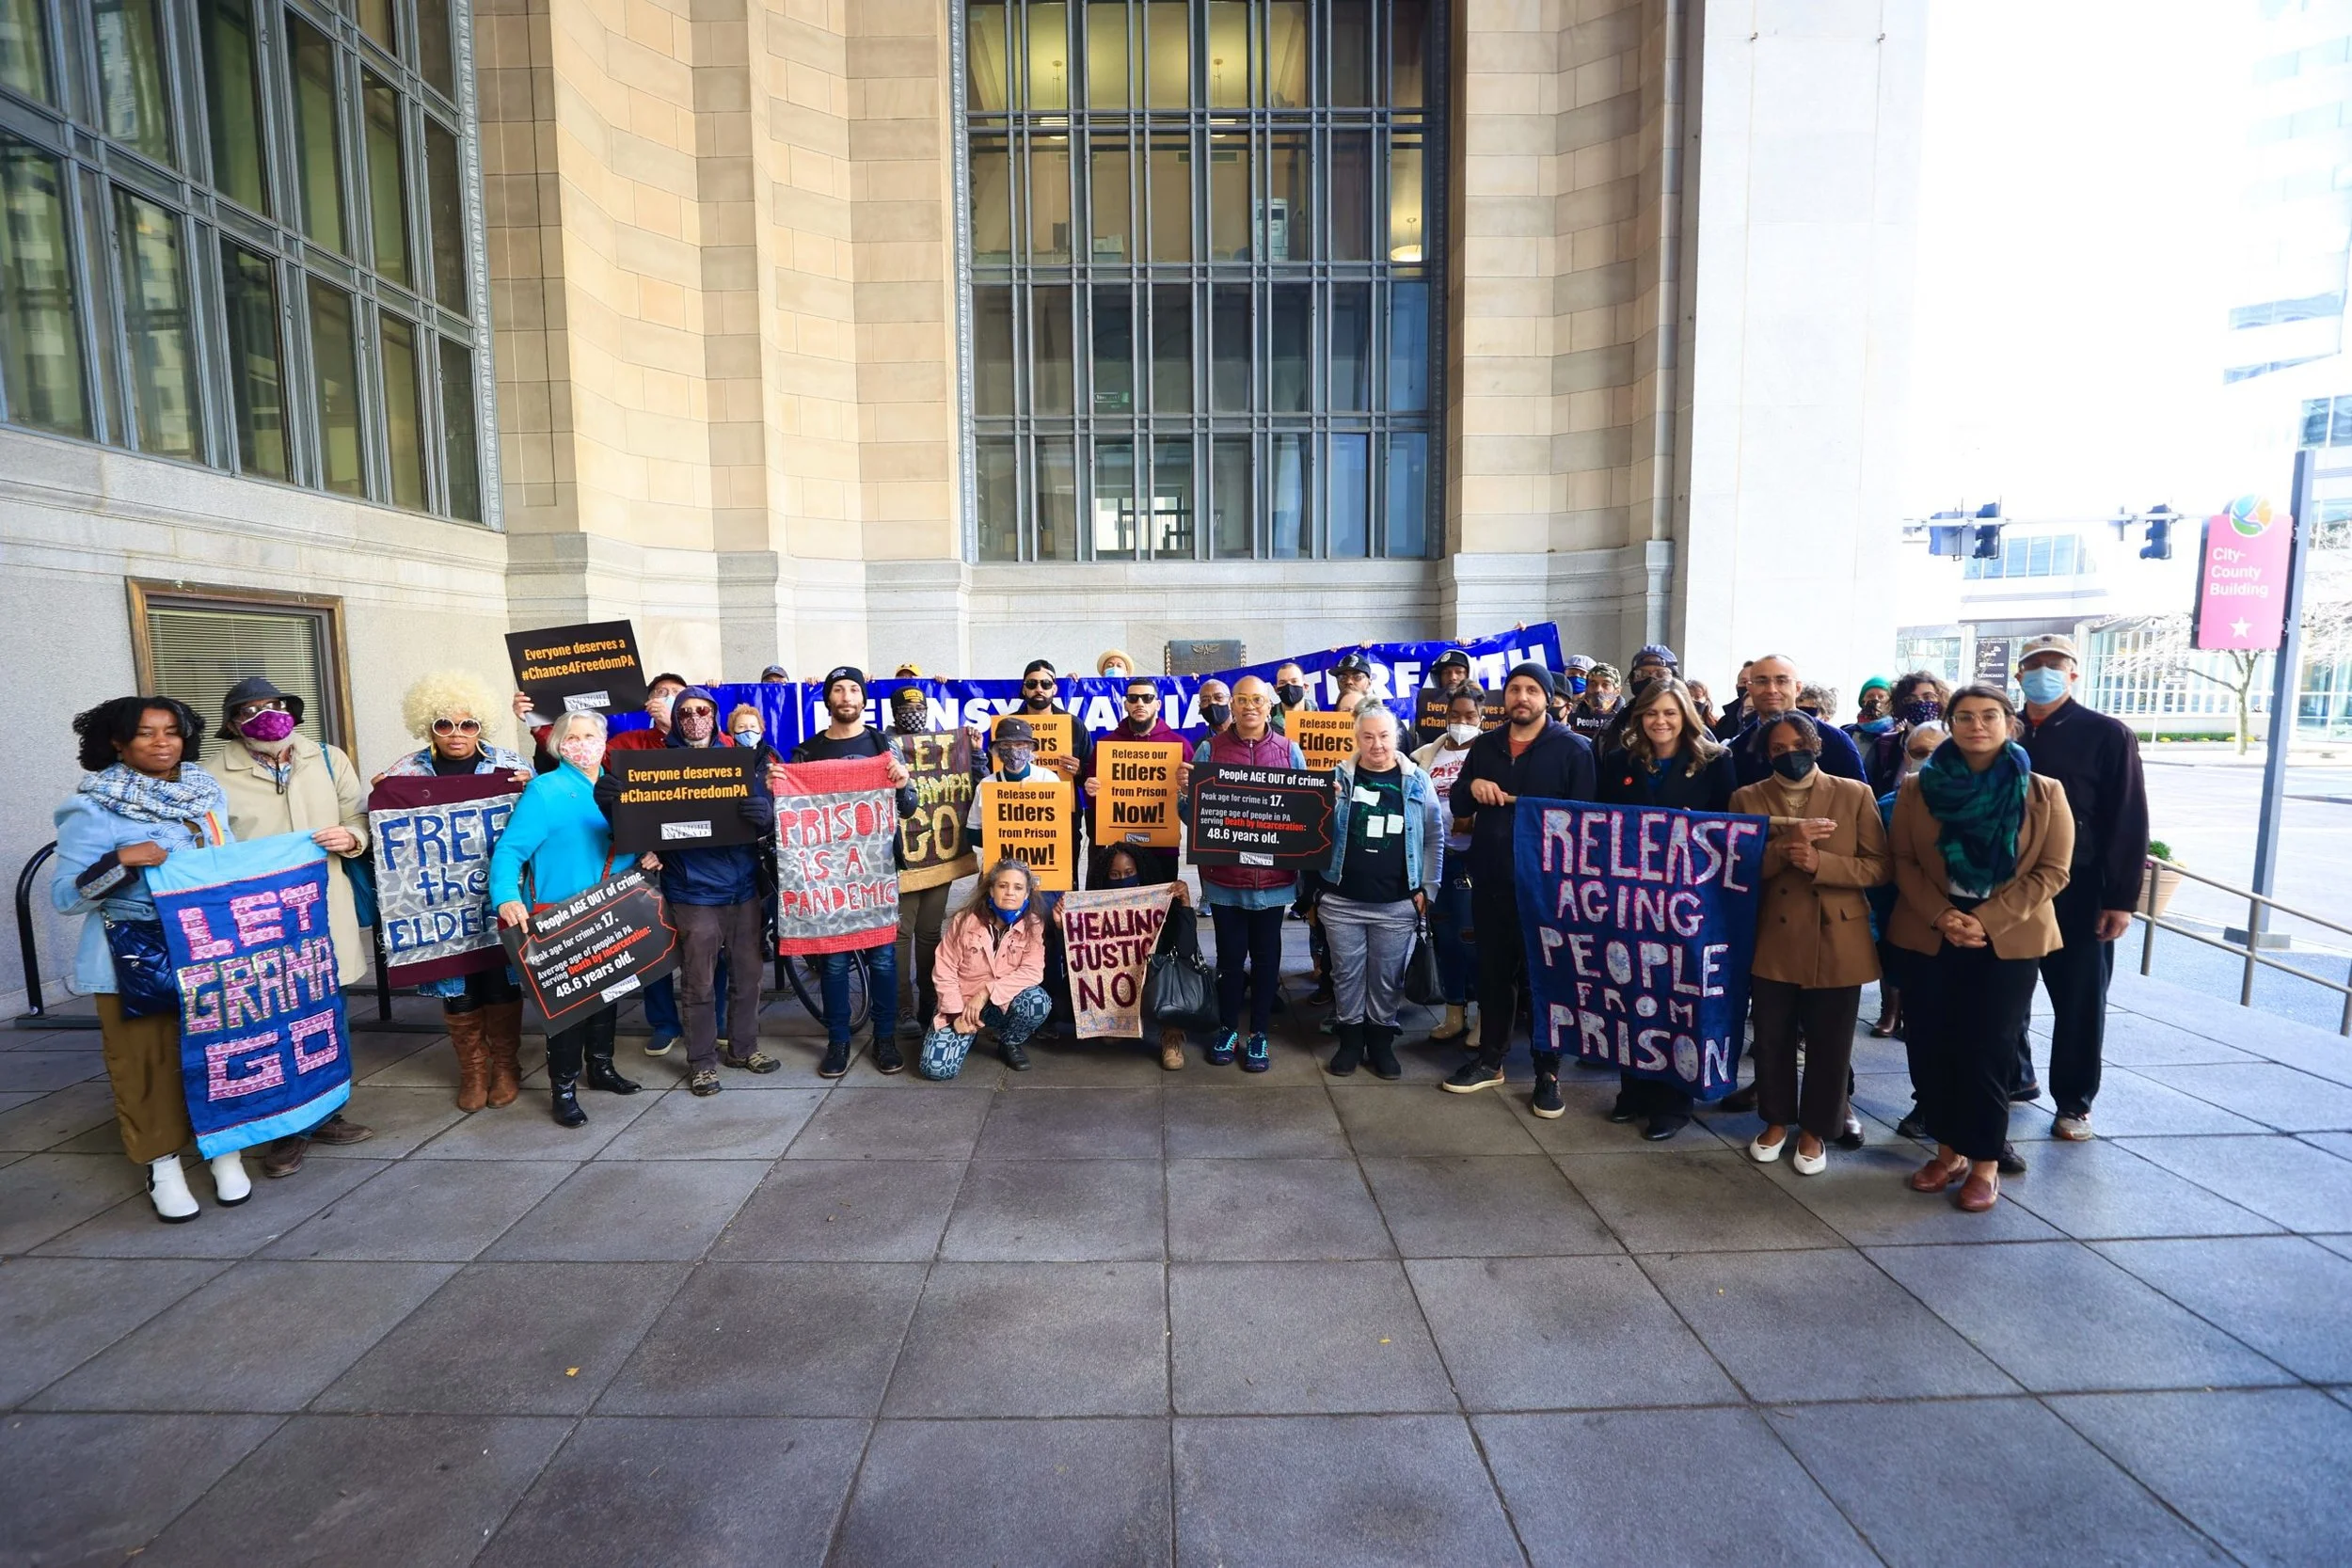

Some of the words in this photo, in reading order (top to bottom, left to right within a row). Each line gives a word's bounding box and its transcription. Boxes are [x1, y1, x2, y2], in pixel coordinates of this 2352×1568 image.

[2212, 546, 2246, 563] City-
[2211, 564, 2262, 581] County
[2210, 582, 2268, 598] Building
[524, 644, 571, 661] Everyone
[573, 640, 617, 654] deserves
[618, 639, 626, 649] a
[521, 654, 635, 681] #Chance4FreedomPA
[1426, 702, 1449, 714] Every
[1042, 722, 1057, 732] our
[1299, 719, 1337, 729] Release
[1339, 721, 1355, 730] our
[1577, 717, 1599, 728] People
[1299, 732, 1354, 752] Elders
[1036, 756, 1059, 767] rison
[1112, 749, 1150, 759] Release
[1152, 751, 1168, 760] our
[628, 768, 680, 784] Everyone
[683, 767, 732, 779] deserves
[734, 767, 742, 778] a
[1112, 763, 1167, 781] Elders
[1219, 768, 1248, 783] People
[1249, 771, 1266, 784] AGE
[1267, 773, 1286, 784] OUT
[1287, 774, 1297, 785] of
[1298, 775, 1327, 787] crime.
[619, 784, 749, 803] #Chance4FreedomPA
[997, 789, 1037, 800] Release
[1039, 791, 1055, 800] our
[1111, 786, 1135, 797] from
[1136, 786, 1168, 797] Prison
[1200, 792, 1216, 801] Peak
[1217, 794, 1230, 803] age
[1231, 793, 1241, 802] for
[1242, 795, 1261, 804] crime
[1262, 797, 1268, 805] is
[1269, 794, 1284, 807] 17.
[997, 803, 1056, 822] Elders
[1113, 801, 1165, 823] Now!
[1200, 808, 1228, 818] Average
[1229, 810, 1241, 818] age
[1242, 810, 1249, 818] of
[1249, 811, 1273, 822] people
[1274, 812, 1280, 821] in
[1281, 813, 1291, 822] PA
[778, 798, 895, 848] PRISON
[899, 804, 960, 863] GO
[998, 828, 1023, 838] from
[1025, 828, 1057, 838] Prison
[1200, 817, 1224, 827] serving
[1224, 817, 1246, 827] Death
[1246, 818, 1255, 830] by
[1207, 828, 1230, 840] 48.6
[1232, 831, 1260, 843] years
[1261, 832, 1280, 845] old.
[1000, 844, 1055, 865] Now!
[1542, 809, 1757, 893] RELEASE
[844, 847, 865, 877] A
[416, 866, 489, 906] the
[535, 909, 571, 933] People
[569, 898, 589, 917] AGE
[587, 889, 607, 907] OUT
[606, 882, 617, 897] of
[616, 872, 645, 892] crime.
[782, 882, 897, 917] PANDEMIC
[1557, 879, 1704, 938] AGING
[178, 881, 321, 960] LET
[529, 950, 549, 965] Peak
[549, 943, 564, 957] age
[563, 937, 575, 949] for
[575, 926, 596, 942] crime
[594, 922, 603, 932] is
[600, 911, 619, 928] 17.
[536, 959, 569, 981] Average
[568, 952, 583, 965] age
[582, 945, 593, 957] of
[592, 934, 615, 956] people
[614, 929, 623, 941] in
[622, 925, 633, 937] PA
[1069, 937, 1153, 973] JUSTIC
[1539, 926, 1729, 998] PEOPLE
[541, 970, 569, 989] serving
[567, 958, 593, 975] Death
[592, 952, 603, 964] by
[556, 976, 582, 998] 48.6
[581, 964, 614, 988] years
[615, 950, 636, 970] old.
[177, 936, 338, 1035] GRAMA
[1077, 972, 1138, 1013] NO
[1576, 982, 1693, 1029] FROM
[205, 1008, 339, 1102] GO
[1549, 1003, 1731, 1088] PRISON
